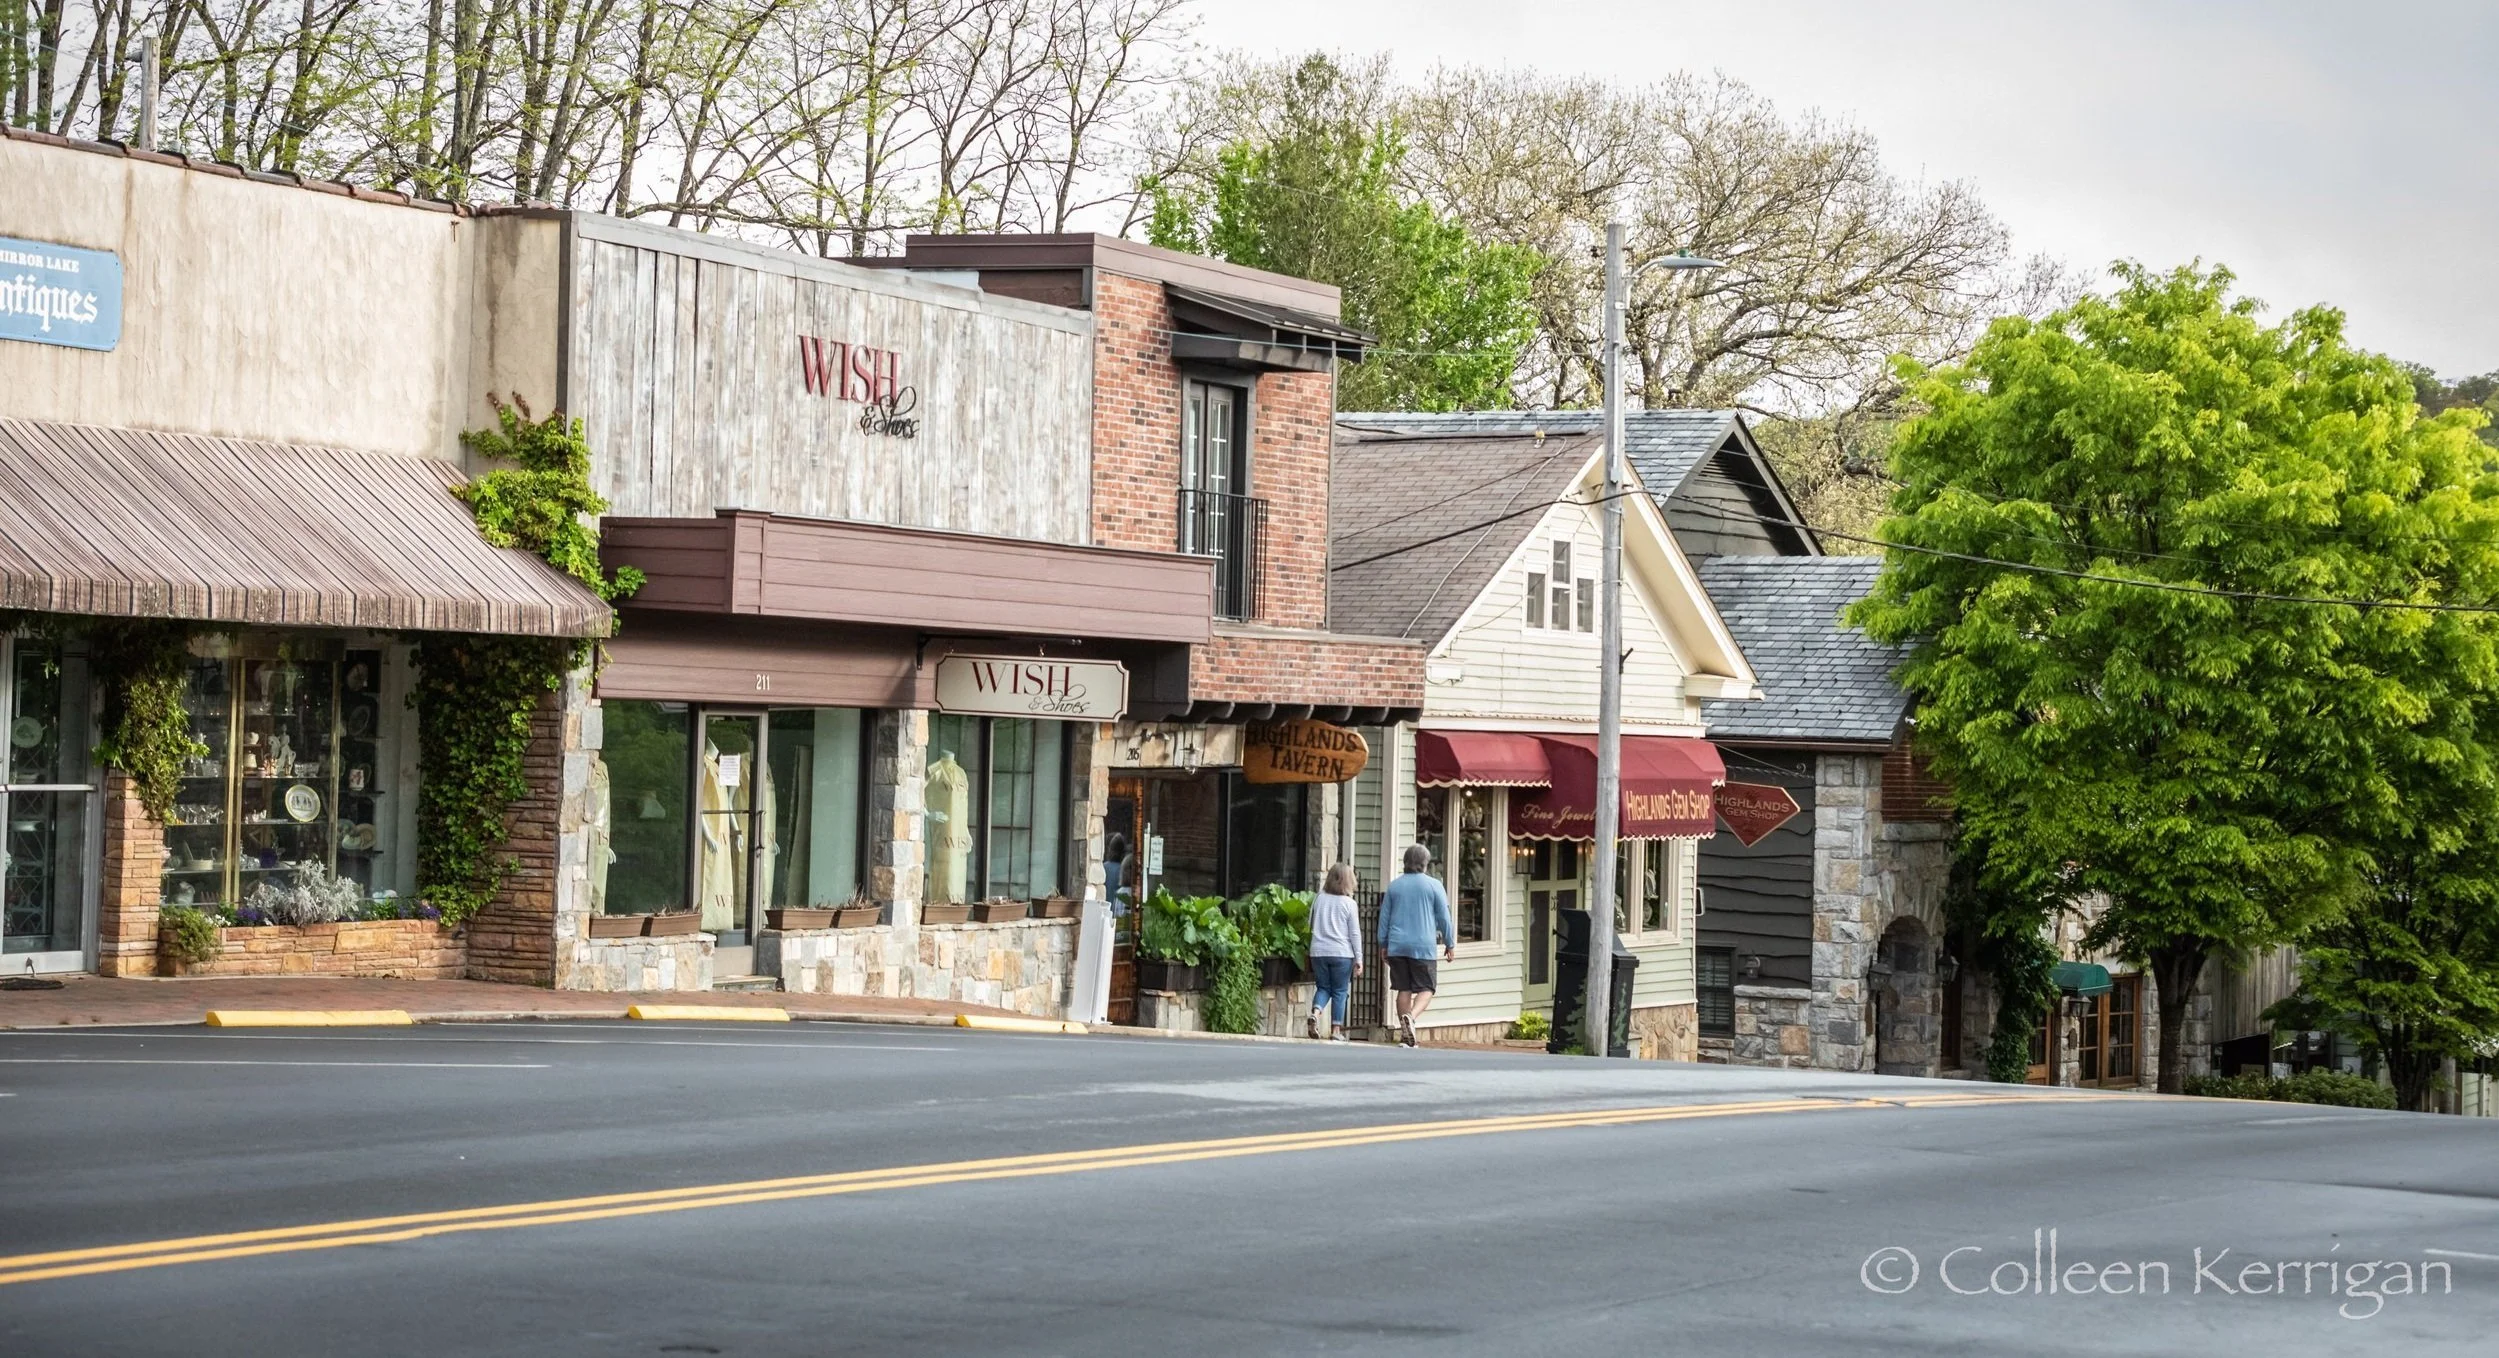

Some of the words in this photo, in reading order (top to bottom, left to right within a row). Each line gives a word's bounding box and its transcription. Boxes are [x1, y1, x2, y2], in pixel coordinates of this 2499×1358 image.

[46, 256, 80, 273] LAKE
[0, 274, 98, 333] ntiques
[798, 335, 901, 406] WISH
[859, 406, 876, 437] &
[873, 386, 920, 439] Shoes
[756, 673, 770, 691] 211
[970, 661, 1074, 697] WISH
[1028, 697, 1043, 710] &
[1043, 684, 1091, 713] Shoes
[1246, 719, 1359, 752] HIGHLANDS
[1270, 745, 1344, 779] TAVERN
[1521, 804, 1554, 820] Fine
[1552, 805, 1597, 829] Jewel
[1626, 790, 1671, 821] HIGHLANDS
[1671, 789, 1689, 820] GEM
[1689, 789, 1710, 820] SHOP
[1714, 794, 1790, 813] HIGHLANDS
[1725, 807, 1748, 817] GEM
[1750, 809, 1778, 820] SHOP
